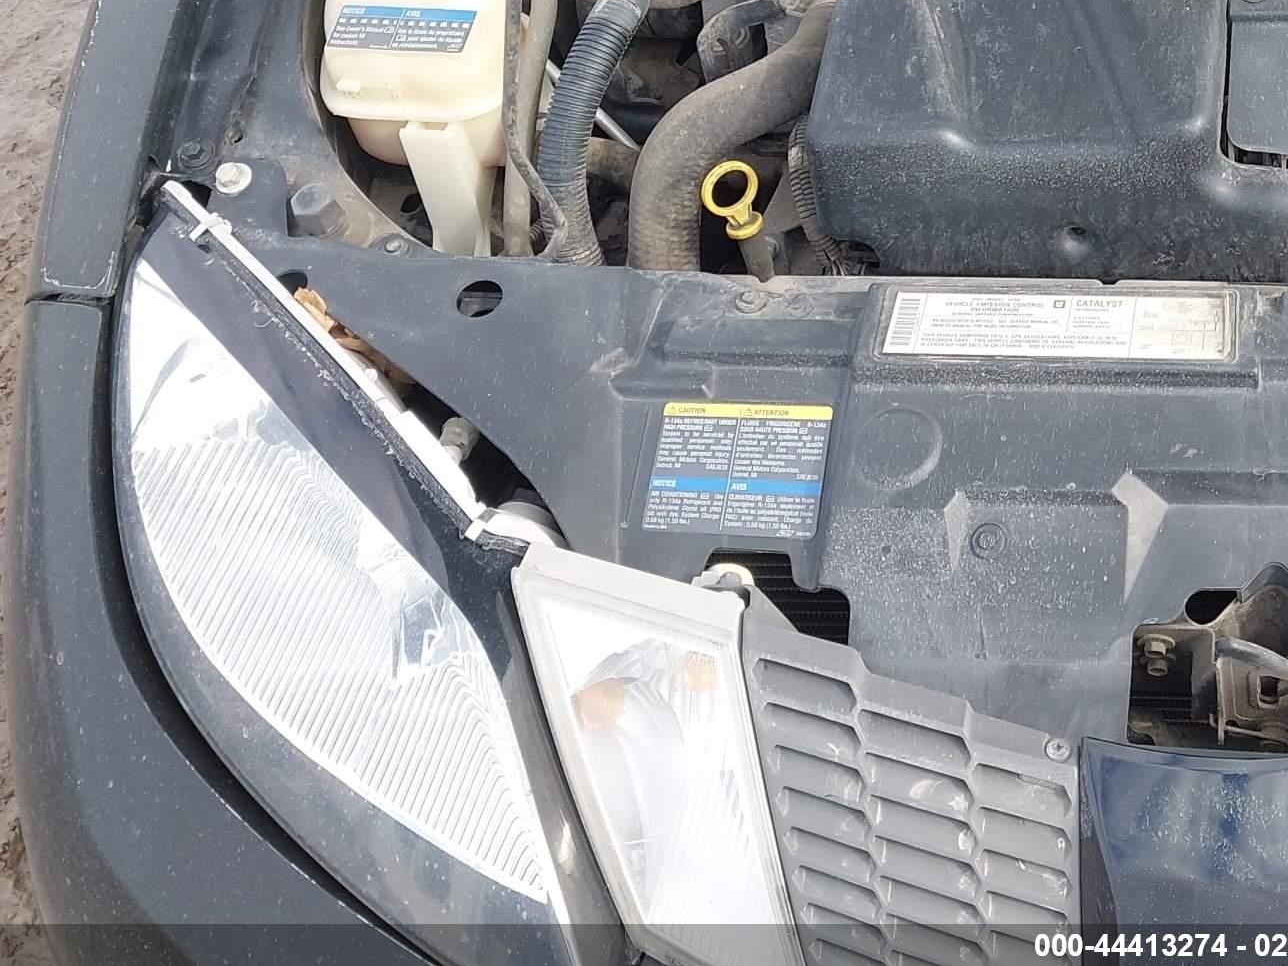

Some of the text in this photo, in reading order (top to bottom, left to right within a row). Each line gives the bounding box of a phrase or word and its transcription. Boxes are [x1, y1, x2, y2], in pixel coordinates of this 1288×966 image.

[1076, 300, 1123, 308] CATALYST
[653, 480, 676, 488] NOTICE
[731, 483, 747, 491] AVIS
